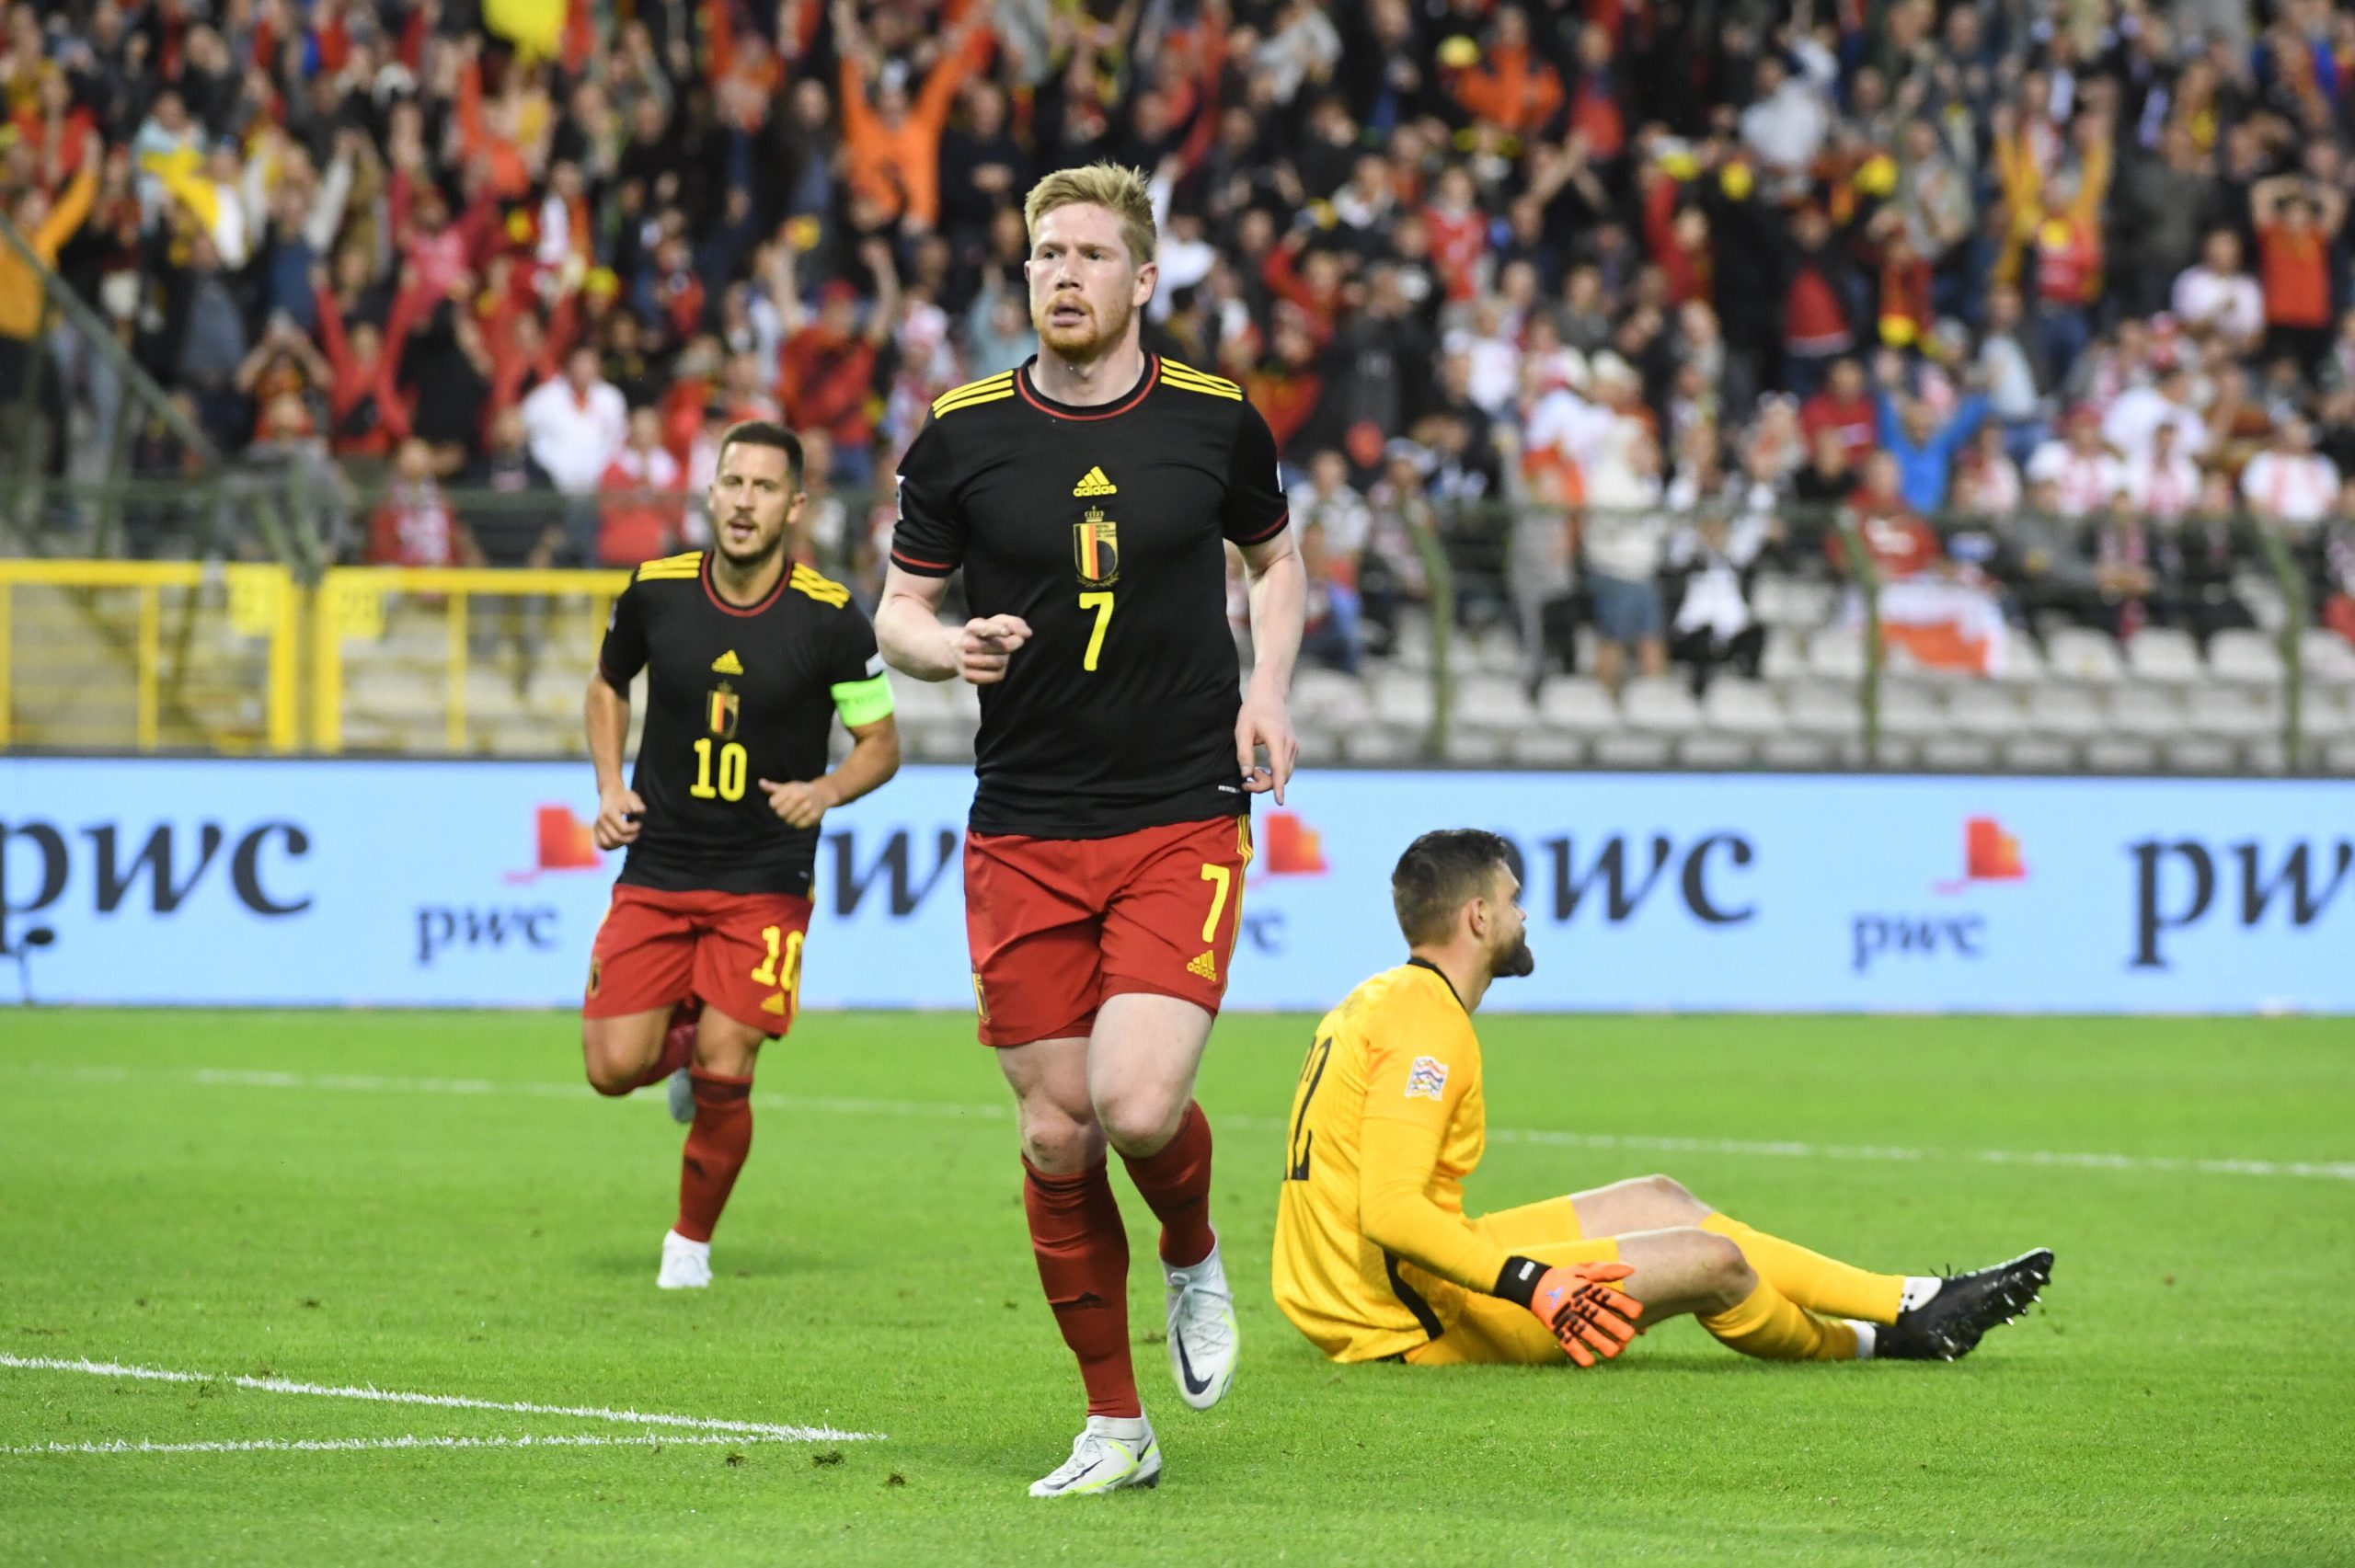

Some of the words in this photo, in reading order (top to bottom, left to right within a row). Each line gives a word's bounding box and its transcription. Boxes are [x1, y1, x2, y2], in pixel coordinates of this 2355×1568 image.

[1073, 484, 1118, 498] adidas
[1079, 591, 1114, 671] 7
[690, 738, 748, 802] 10
[0, 821, 313, 958] pwc
[1200, 863, 1231, 943] 7
[1507, 831, 1756, 925] wc
[417, 903, 559, 966] pwc
[751, 925, 804, 991] 10
[1851, 916, 1984, 970] pwc
[1284, 1036, 1332, 1182] 2
